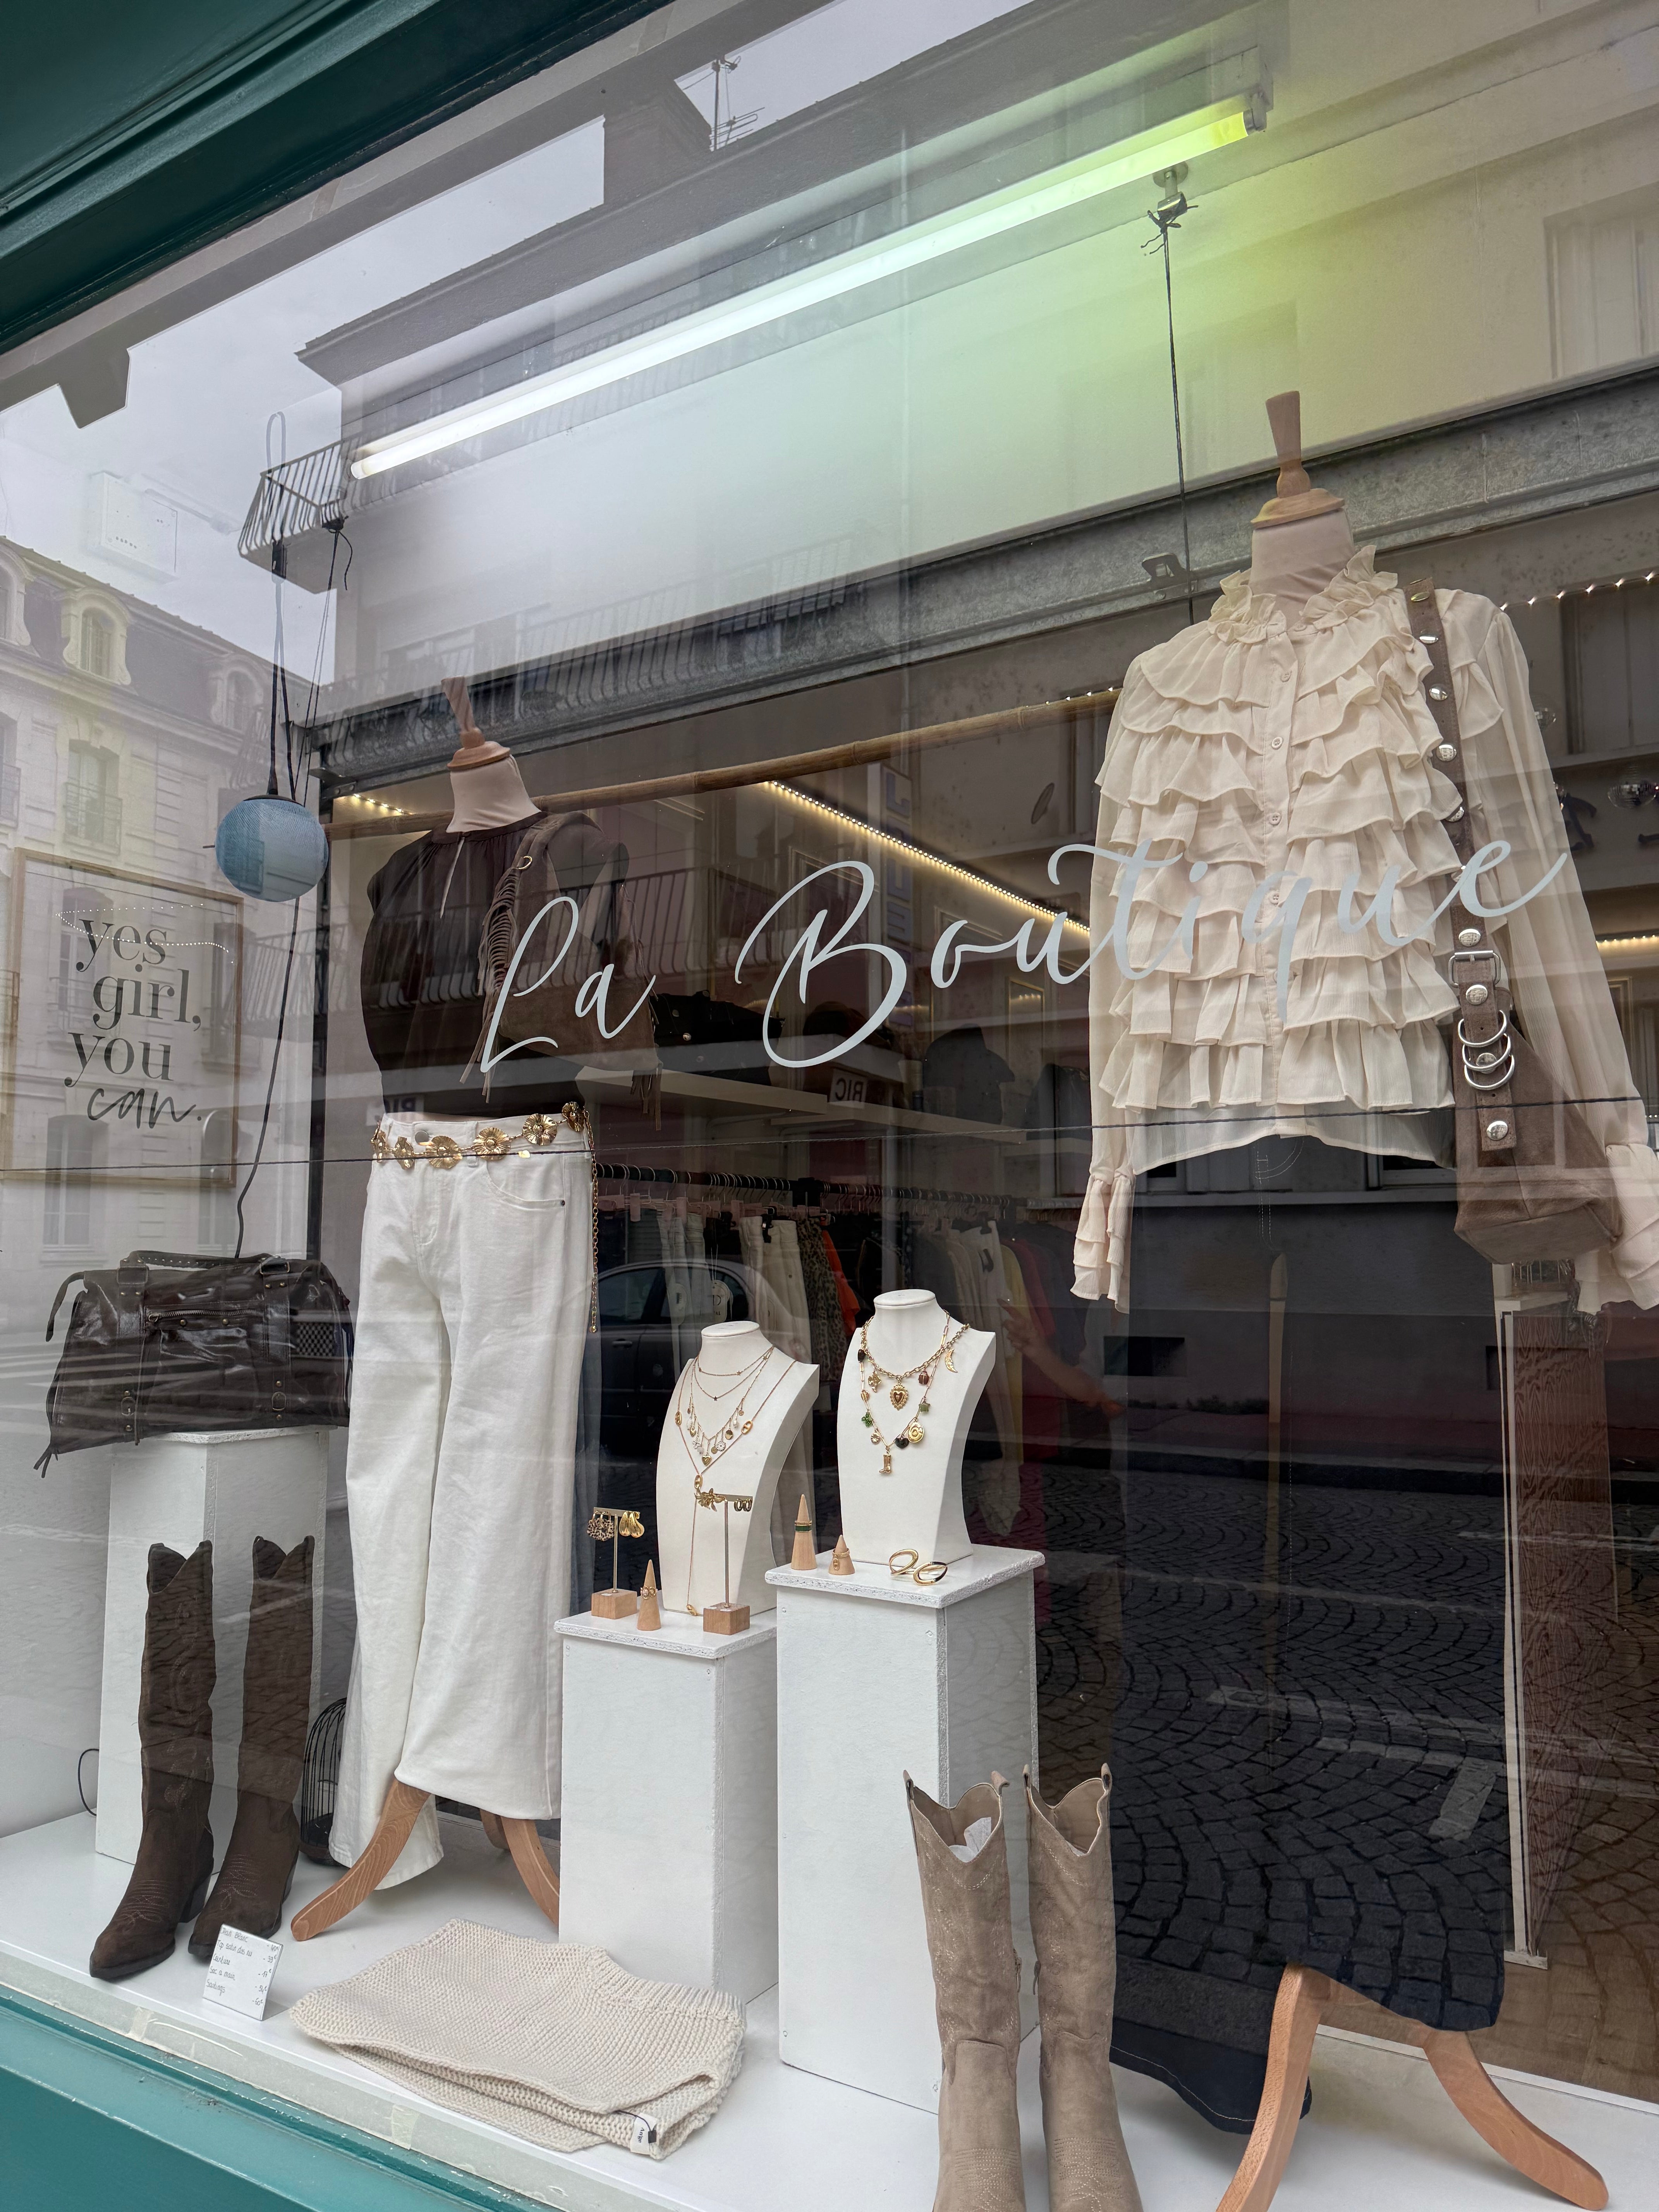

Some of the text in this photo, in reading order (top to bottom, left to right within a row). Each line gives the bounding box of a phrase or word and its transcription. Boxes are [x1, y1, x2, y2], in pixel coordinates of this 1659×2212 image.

[76, 919, 167, 972] yes
[480, 840, 1568, 1073] La Boutique
[93, 964, 201, 1032] girl,
[64, 1032, 174, 1087] you
[87, 1088, 202, 1128] can.
[226, 1943, 236, 1951] satin
[224, 1972, 235, 1980] main
